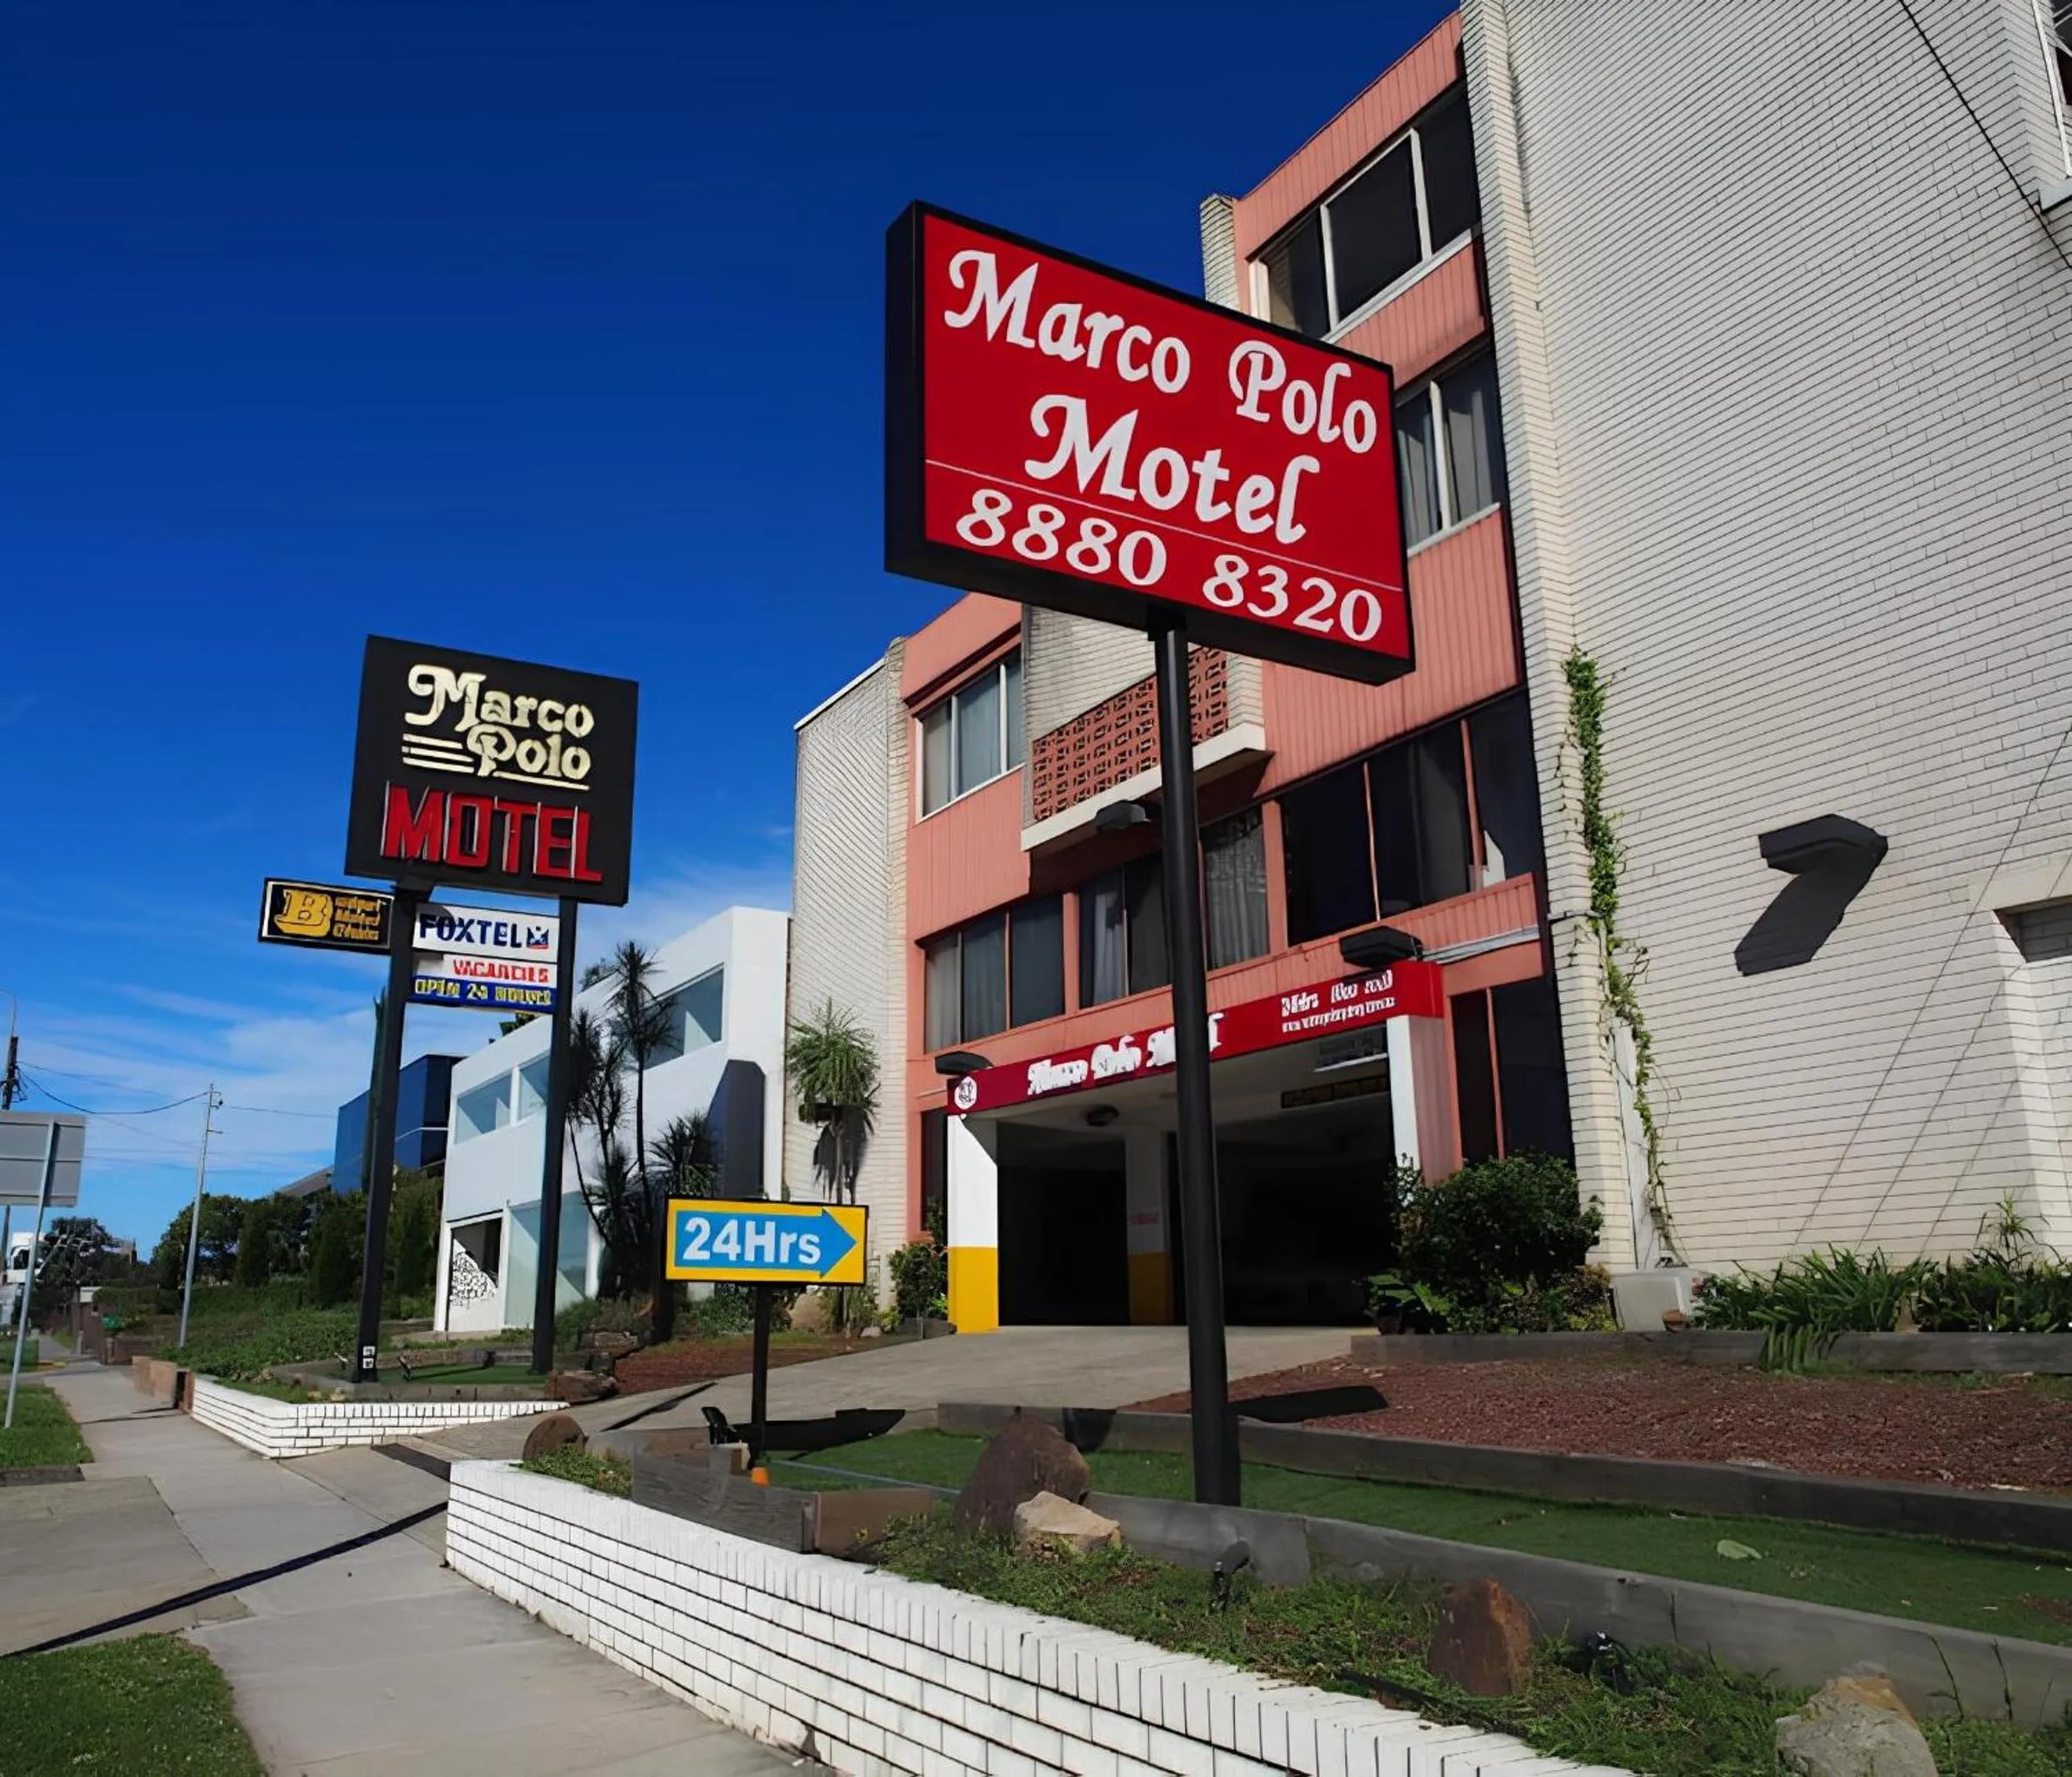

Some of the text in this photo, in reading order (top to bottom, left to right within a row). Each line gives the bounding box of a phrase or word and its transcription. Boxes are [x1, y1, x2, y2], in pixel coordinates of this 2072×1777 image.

[944, 250, 1377, 454] Marco Polo
[1024, 394, 1319, 544] Motel
[956, 489, 1382, 642] 8880 8320
[404, 664, 595, 739] Marco
[466, 724, 591, 780] Polo
[380, 780, 603, 882] MOTEL
[419, 913, 523, 949] FOXTEL
[682, 1217, 821, 1265] 24Hrs
